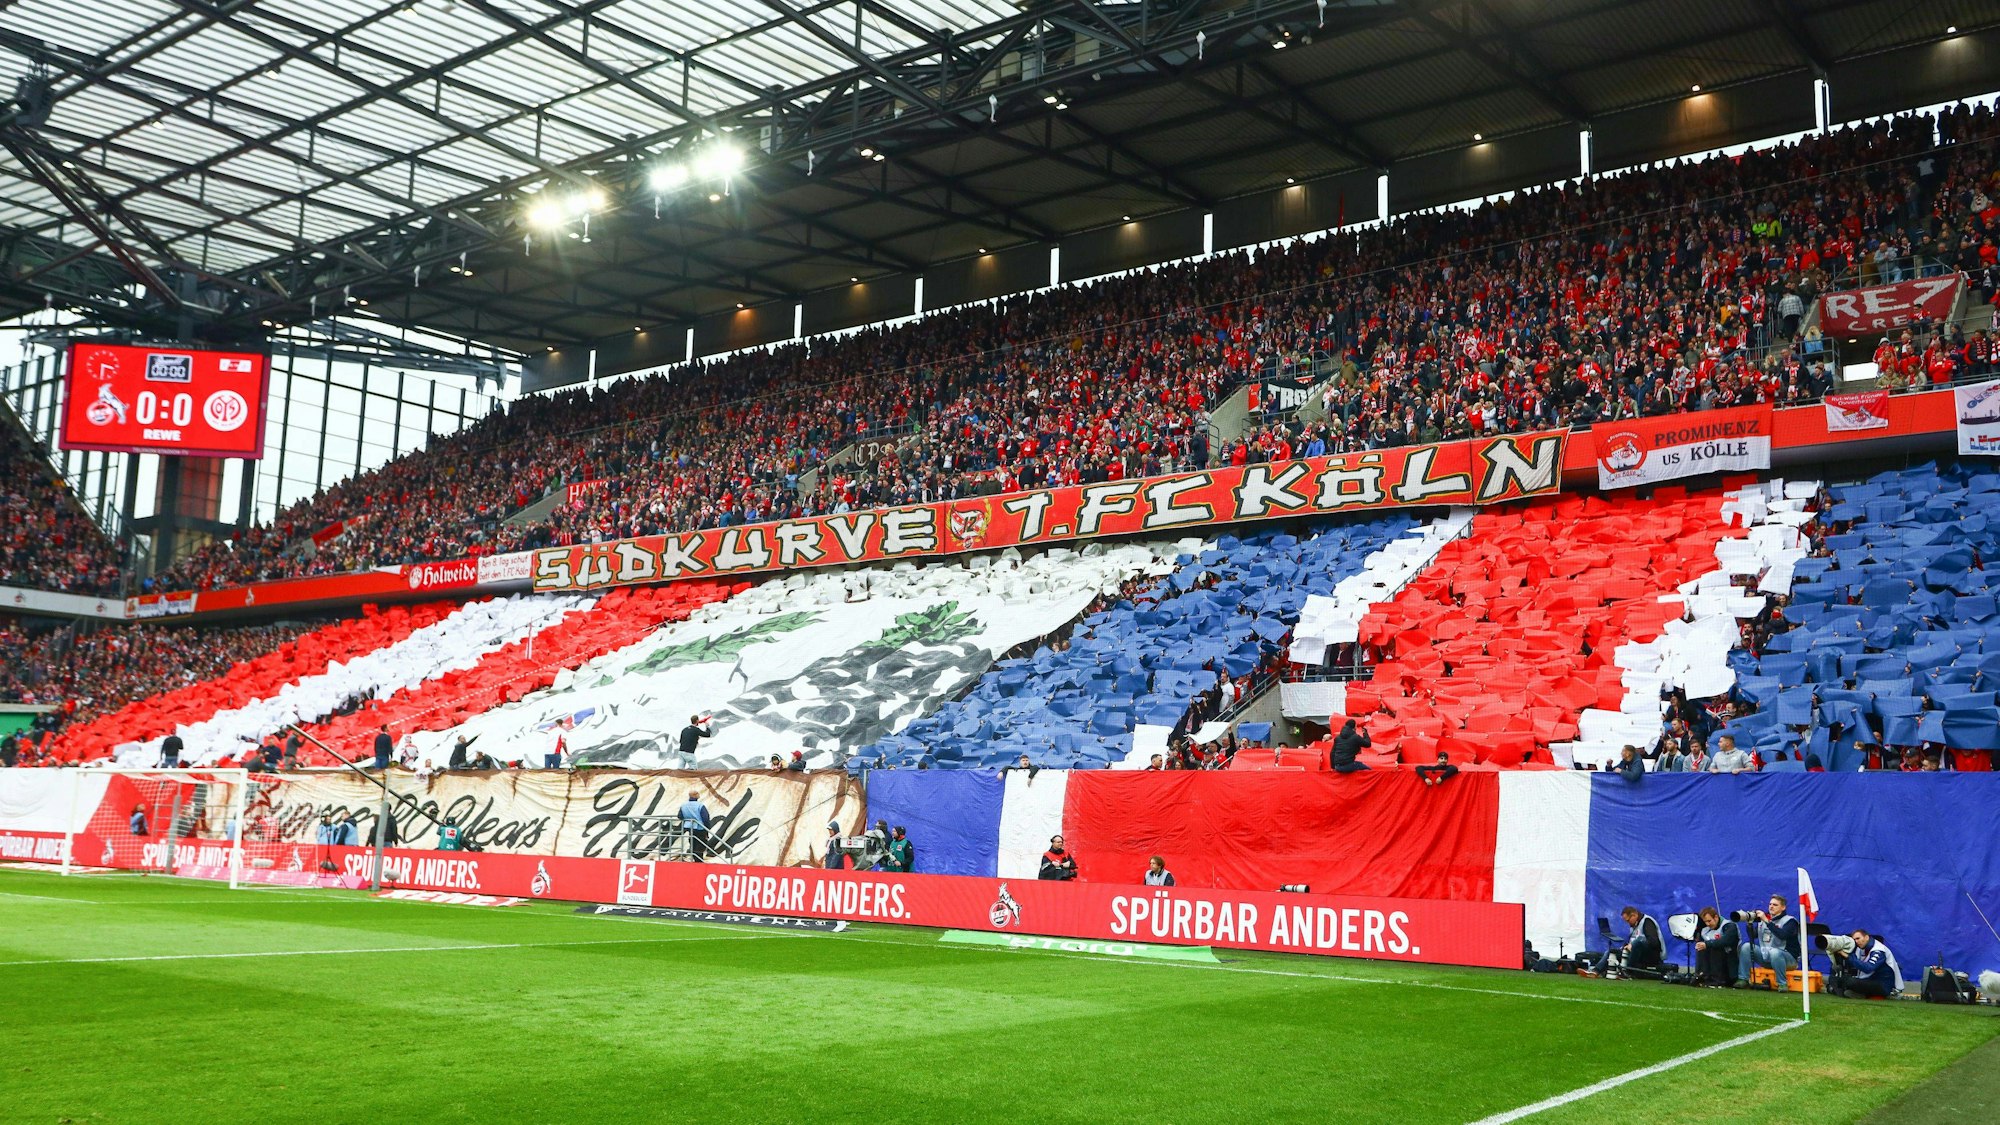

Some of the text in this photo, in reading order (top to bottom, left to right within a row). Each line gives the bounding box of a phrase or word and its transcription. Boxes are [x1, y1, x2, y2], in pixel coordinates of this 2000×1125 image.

[1826, 278, 1956, 319] RE7
[1848, 314, 1909, 331] CRE
[135, 391, 193, 426] 0:0
[143, 428, 182, 441] REWE
[1654, 420, 1761, 447] PROMINENZ
[1690, 441, 1749, 461] KÖLLE
[1233, 435, 1564, 520] KÖLN
[499, 557, 509, 567] Tag
[534, 506, 939, 590] SÜDKURVE
[422, 563, 476, 588] Holweide
[443, 794, 551, 849] Years
[140, 838, 196, 868] SPÜBAR
[414, 858, 481, 889] ANDERS.
[704, 868, 912, 919] SPÜRBAR ANDERS.
[1110, 891, 1422, 956] SPÜRBAR ANDERS.
